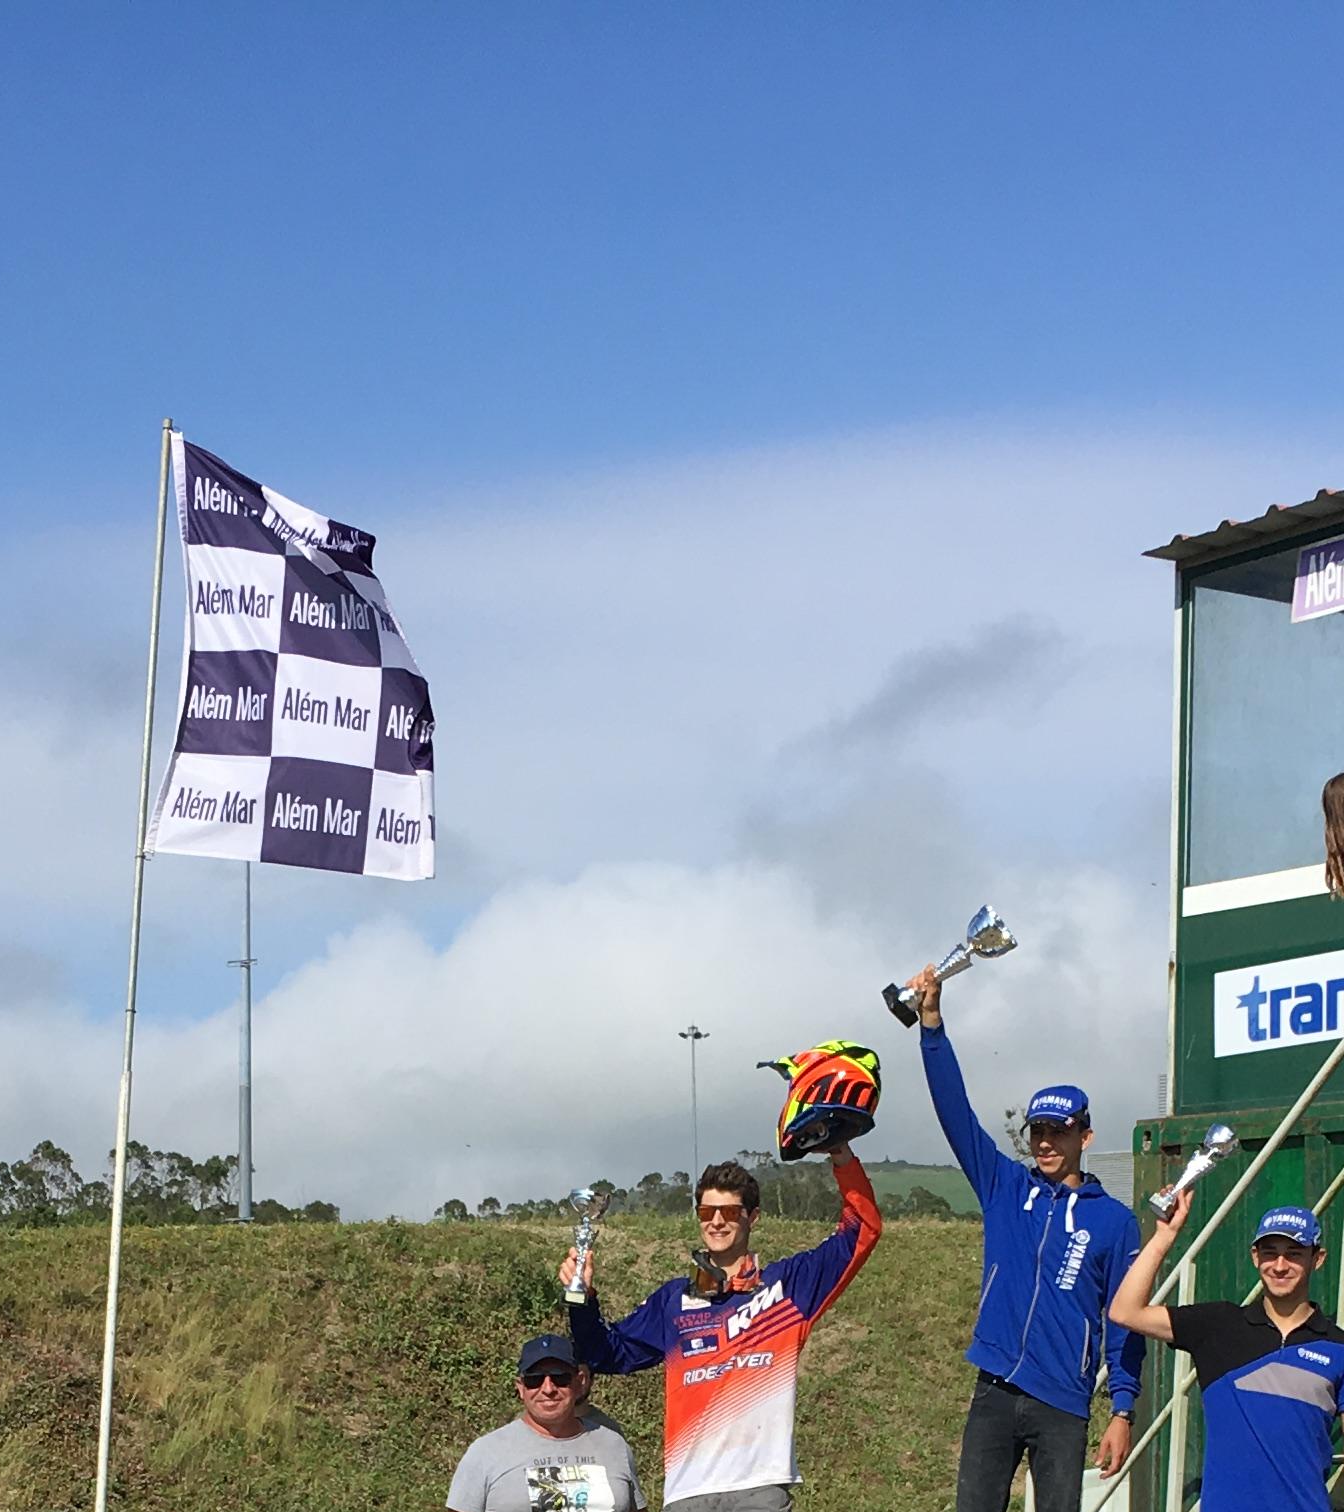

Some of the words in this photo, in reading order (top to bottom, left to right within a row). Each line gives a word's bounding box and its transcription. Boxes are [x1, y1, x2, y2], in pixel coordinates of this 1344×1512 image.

[195, 581, 235, 615] Além
[239, 585, 274, 618] Mar
[290, 592, 336, 629] Além
[341, 594, 371, 630] Mar
[187, 685, 232, 720] Além
[235, 686, 267, 721] Mar
[281, 687, 327, 725] Além
[334, 696, 371, 732] Mar
[171, 787, 217, 822] Além
[220, 791, 257, 824] Mar
[272, 792, 318, 831] Além
[323, 797, 362, 837] Mar
[376, 807, 421, 845] Além
[1272, 1214, 1307, 1228] YAMAHA
[1059, 1244, 1087, 1291] YAMAHA
[727, 1280, 784, 1339] KTM
[533, 1456, 551, 1466] OUT
[558, 1456, 568, 1464] OF
[575, 1456, 596, 1464] THIS
